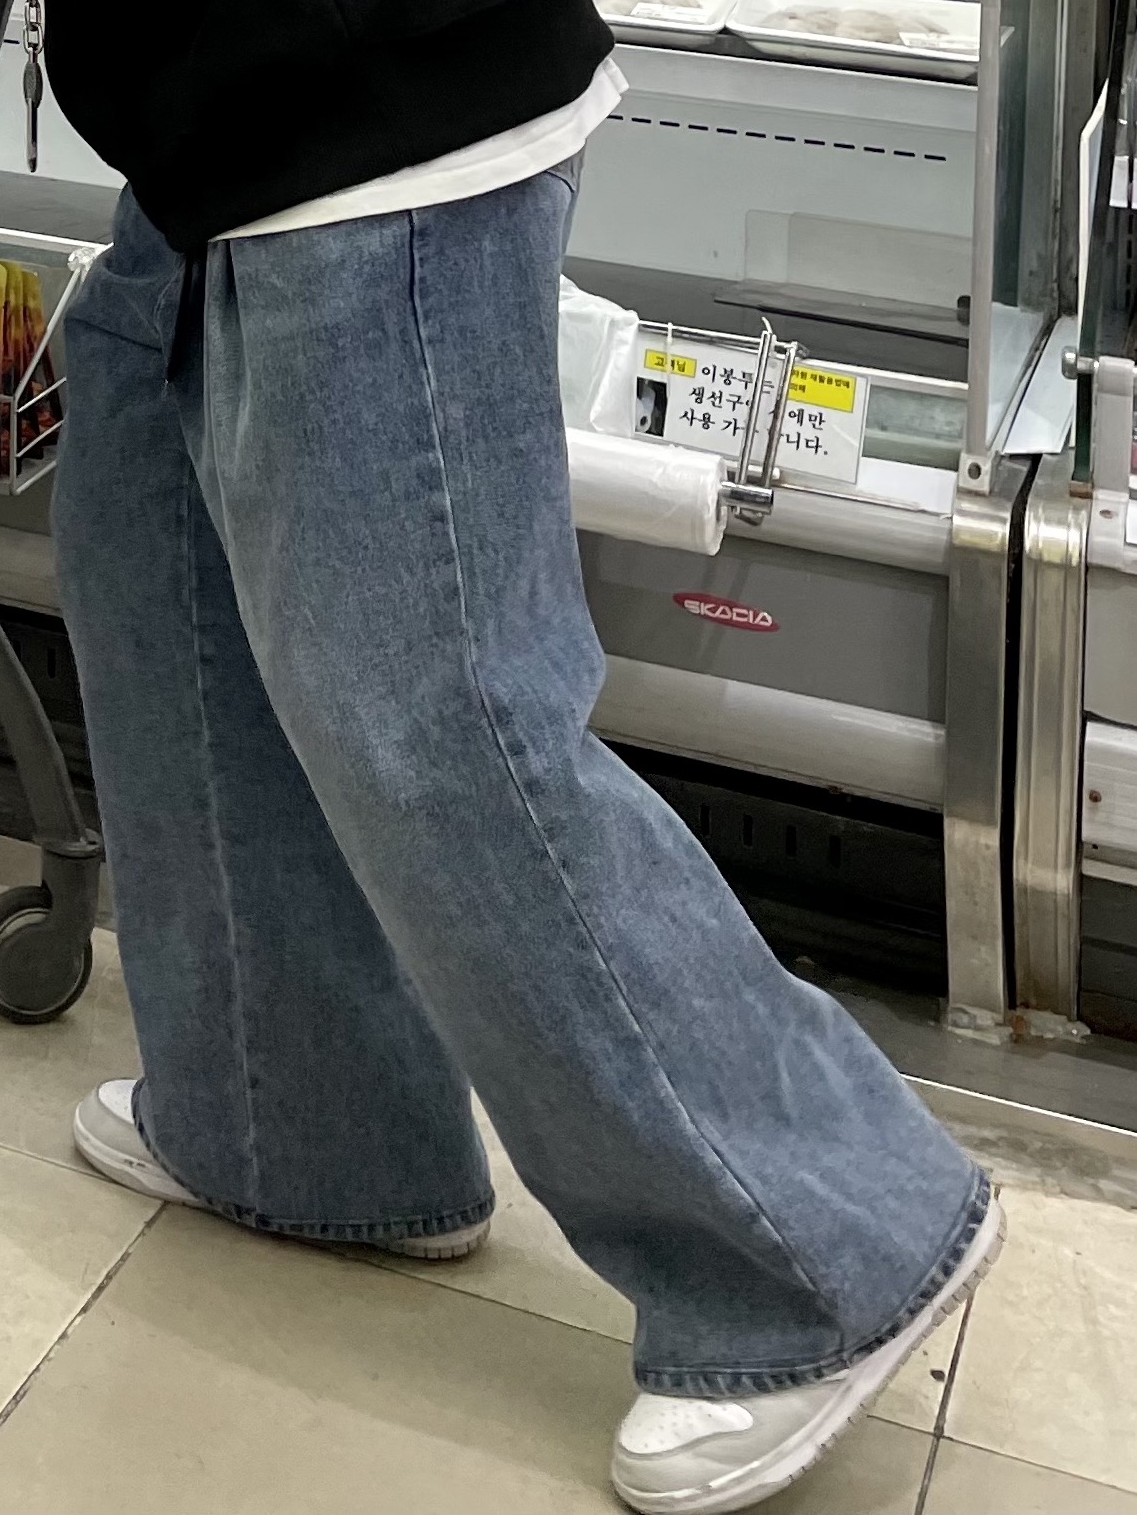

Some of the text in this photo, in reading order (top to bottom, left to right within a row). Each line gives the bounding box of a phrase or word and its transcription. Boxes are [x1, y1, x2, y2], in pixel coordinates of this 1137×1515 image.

[654, 353, 687, 373] 고님
[689, 386, 751, 412] 생선구
[679, 407, 828, 455] 사용 가니다.
